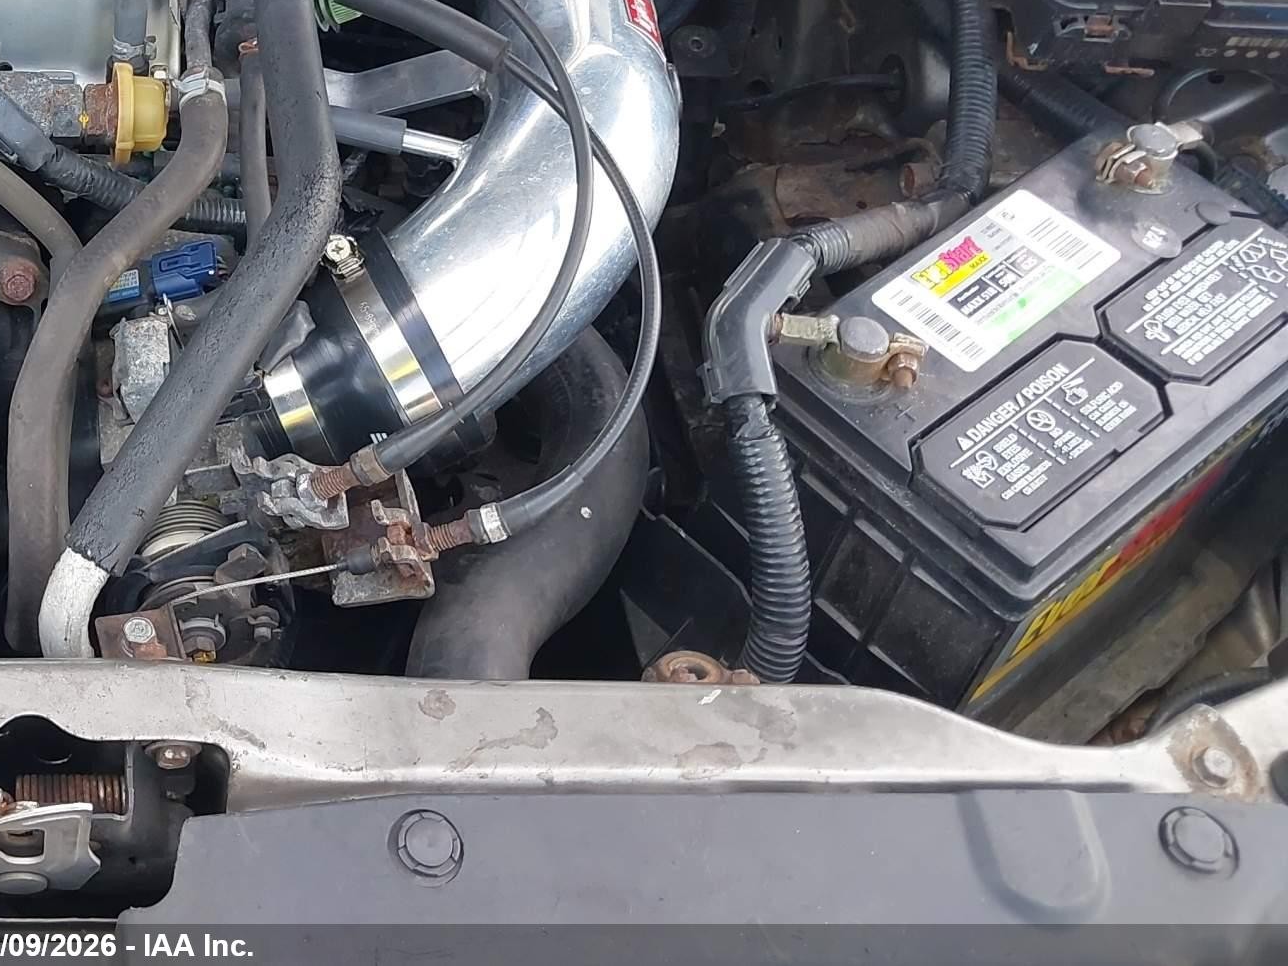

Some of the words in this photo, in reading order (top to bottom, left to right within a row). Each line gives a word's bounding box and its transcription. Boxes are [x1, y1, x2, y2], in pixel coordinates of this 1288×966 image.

[966, 397, 1020, 442] DANGER
[1022, 362, 1070, 401] POISON
[992, 432, 1018, 453] SHIELD
[996, 446, 1033, 476] EXPLOSIVE
[1005, 462, 1030, 482] GASES
